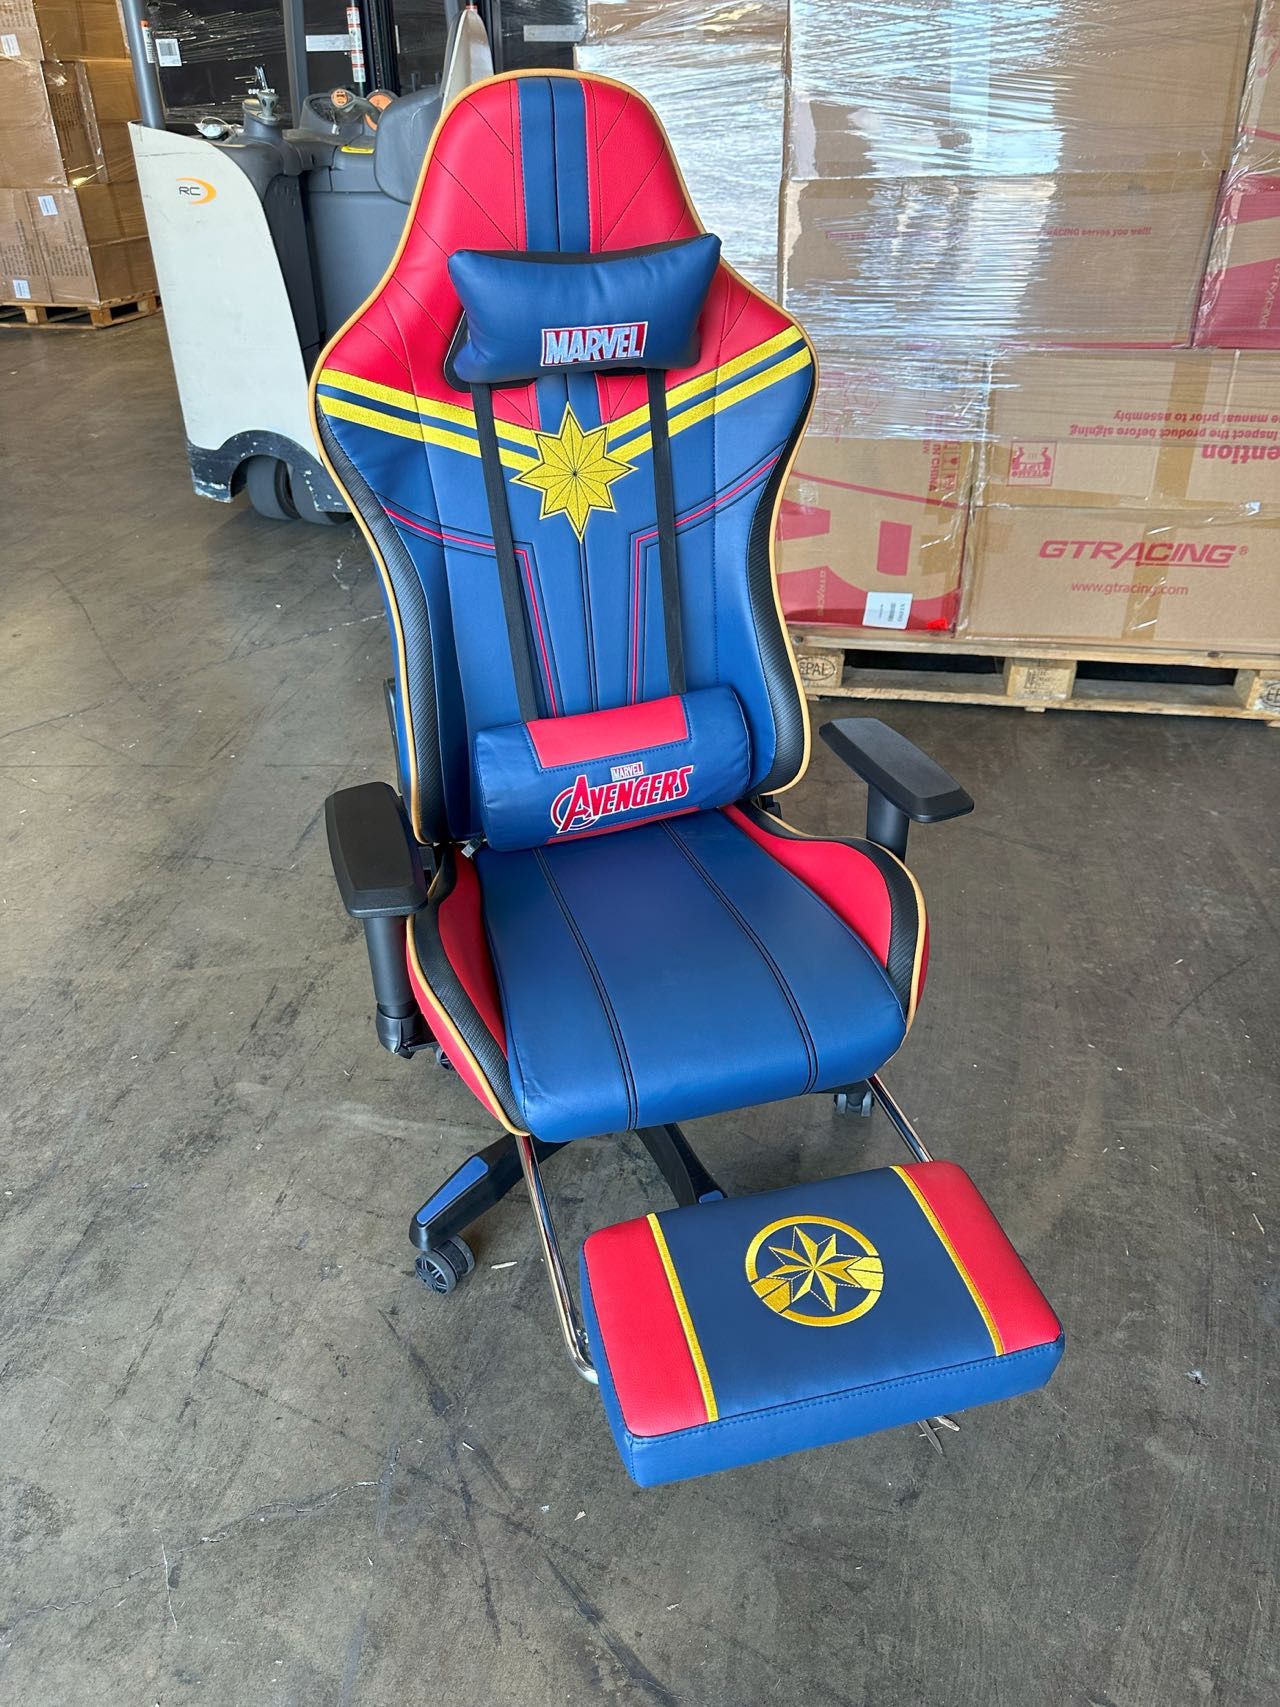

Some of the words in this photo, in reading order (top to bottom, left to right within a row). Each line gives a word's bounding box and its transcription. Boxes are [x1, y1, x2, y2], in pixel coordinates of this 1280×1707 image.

[178, 186, 201, 196] RC
[544, 325, 641, 365] MARVEL
[1113, 410, 1171, 423] assembly
[1174, 412, 1187, 424] to
[1189, 411, 1220, 424] prior
[1069, 424, 1113, 437] signing
[1116, 425, 1156, 439] before
[1159, 426, 1207, 440] product
[1209, 428, 1230, 440] the
[1071, 582, 1189, 597] www.gtracing.com
[612, 762, 644, 780] MARVEL
[551, 764, 695, 834] AVENGERS
